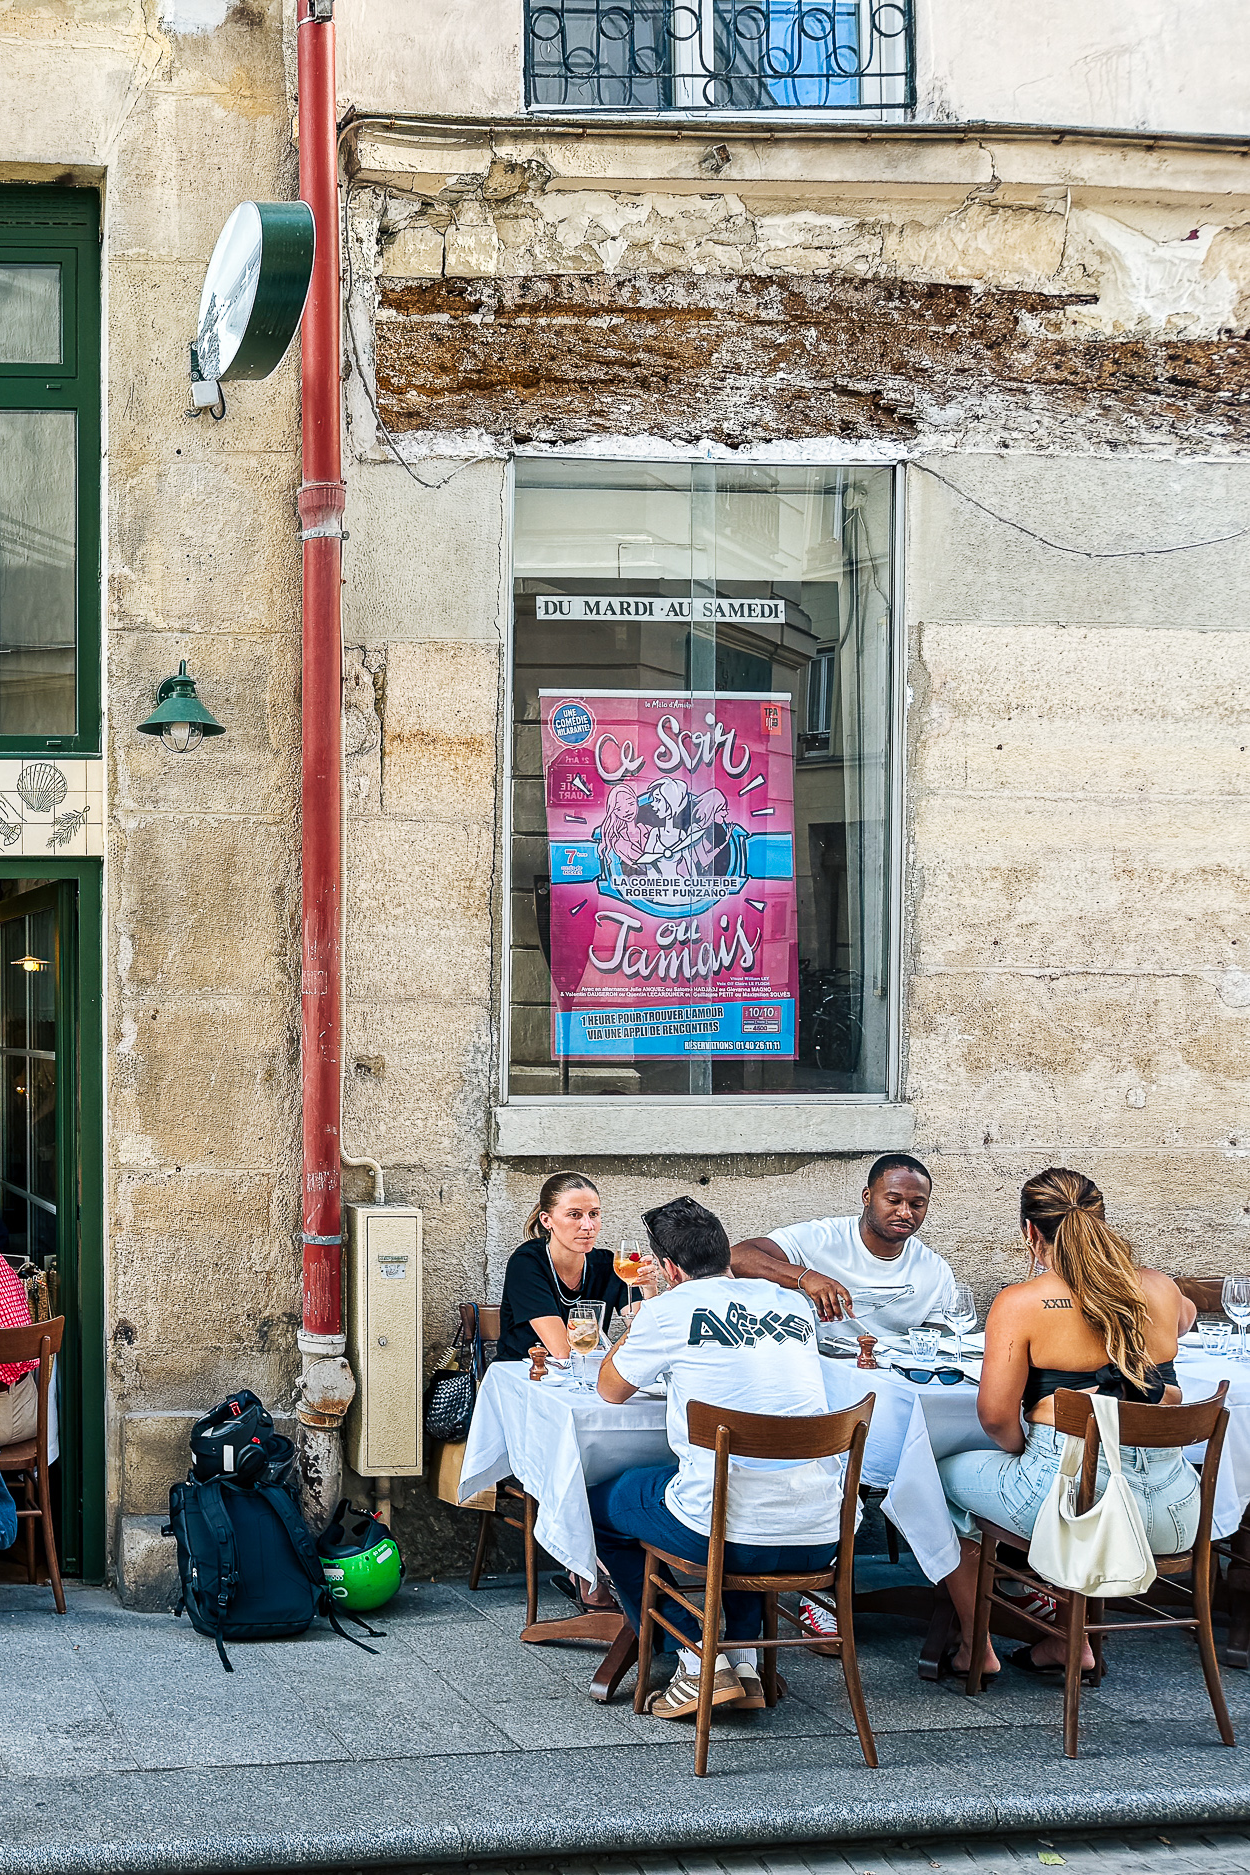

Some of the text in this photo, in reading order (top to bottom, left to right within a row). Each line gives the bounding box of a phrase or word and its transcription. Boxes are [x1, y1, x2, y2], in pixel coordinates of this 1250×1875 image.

[583, 600, 654, 617] MARDI
[563, 708, 577, 717] UNE
[555, 715, 589, 729] COMÉDIE
[595, 712, 751, 784] Ce Soir
[613, 878, 628, 887] LA
[683, 878, 719, 887] CULTE
[723, 879, 737, 887] DE
[625, 888, 727, 897] ROBERT PUNZANO
[656, 919, 702, 948] ou
[589, 910, 761, 981] Jamais
[581, 1015, 587, 1026] 1
[588, 1013, 617, 1026] HEURE
[618, 1011, 642, 1024] POUR
[643, 1009, 684, 1022] TROUVER
[749, 1008, 774, 1017] 10/10
[587, 1028, 602, 1040] VIA
[604, 1027, 623, 1039] UNE
[623, 1025, 648, 1038] APPLI
[650, 1024, 661, 1036] DE
[735, 1041, 745, 1050] 01
[745, 1041, 755, 1050] 40
[755, 1041, 765, 1050] 26
[1041, 1299, 1073, 1309] XXIII
